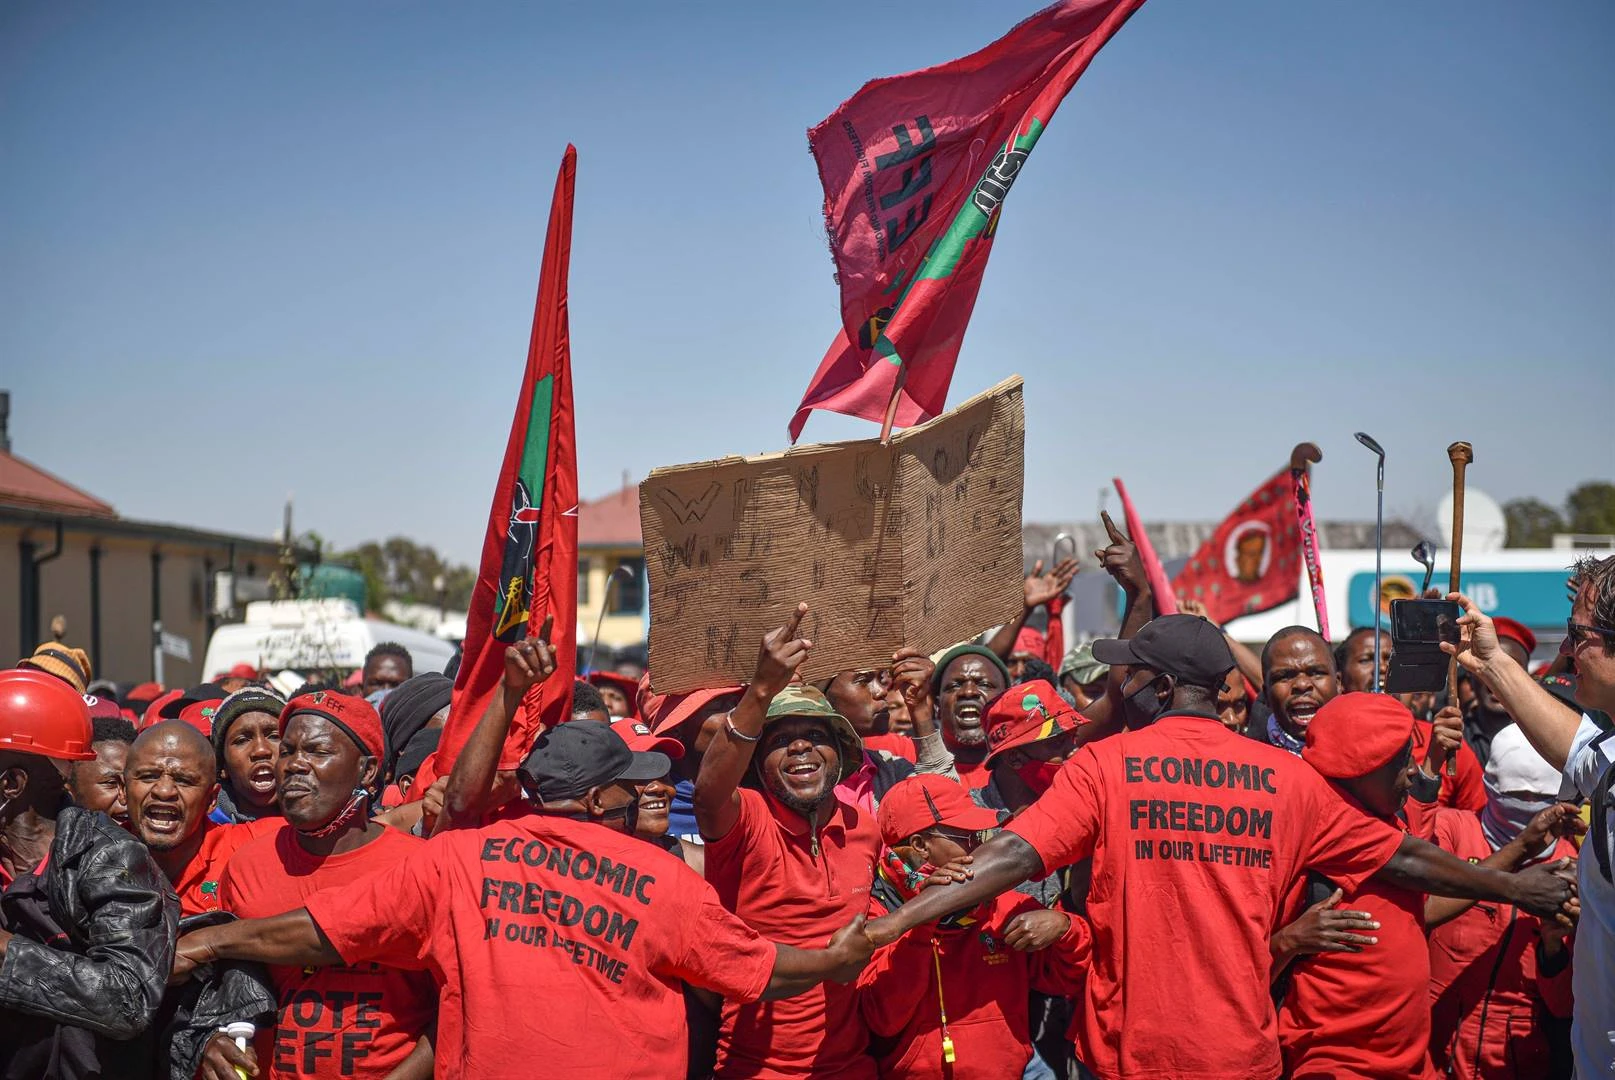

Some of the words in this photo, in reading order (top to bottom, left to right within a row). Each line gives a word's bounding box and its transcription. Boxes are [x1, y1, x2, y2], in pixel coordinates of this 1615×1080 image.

[326, 697, 345, 712] EFF
[1125, 756, 1277, 794] ECONOMIC
[1130, 800, 1272, 839] FREEDOM
[480, 837, 656, 905] ECONOMIC
[1135, 840, 1153, 860] IN
[1159, 840, 1194, 861] OUR
[1200, 842, 1273, 869] LIFETIME
[480, 877, 639, 951] FREEDOM
[505, 923, 547, 947] OUR
[551, 930, 628, 984] LFETIME
[275, 1029, 372, 1076] EFF
